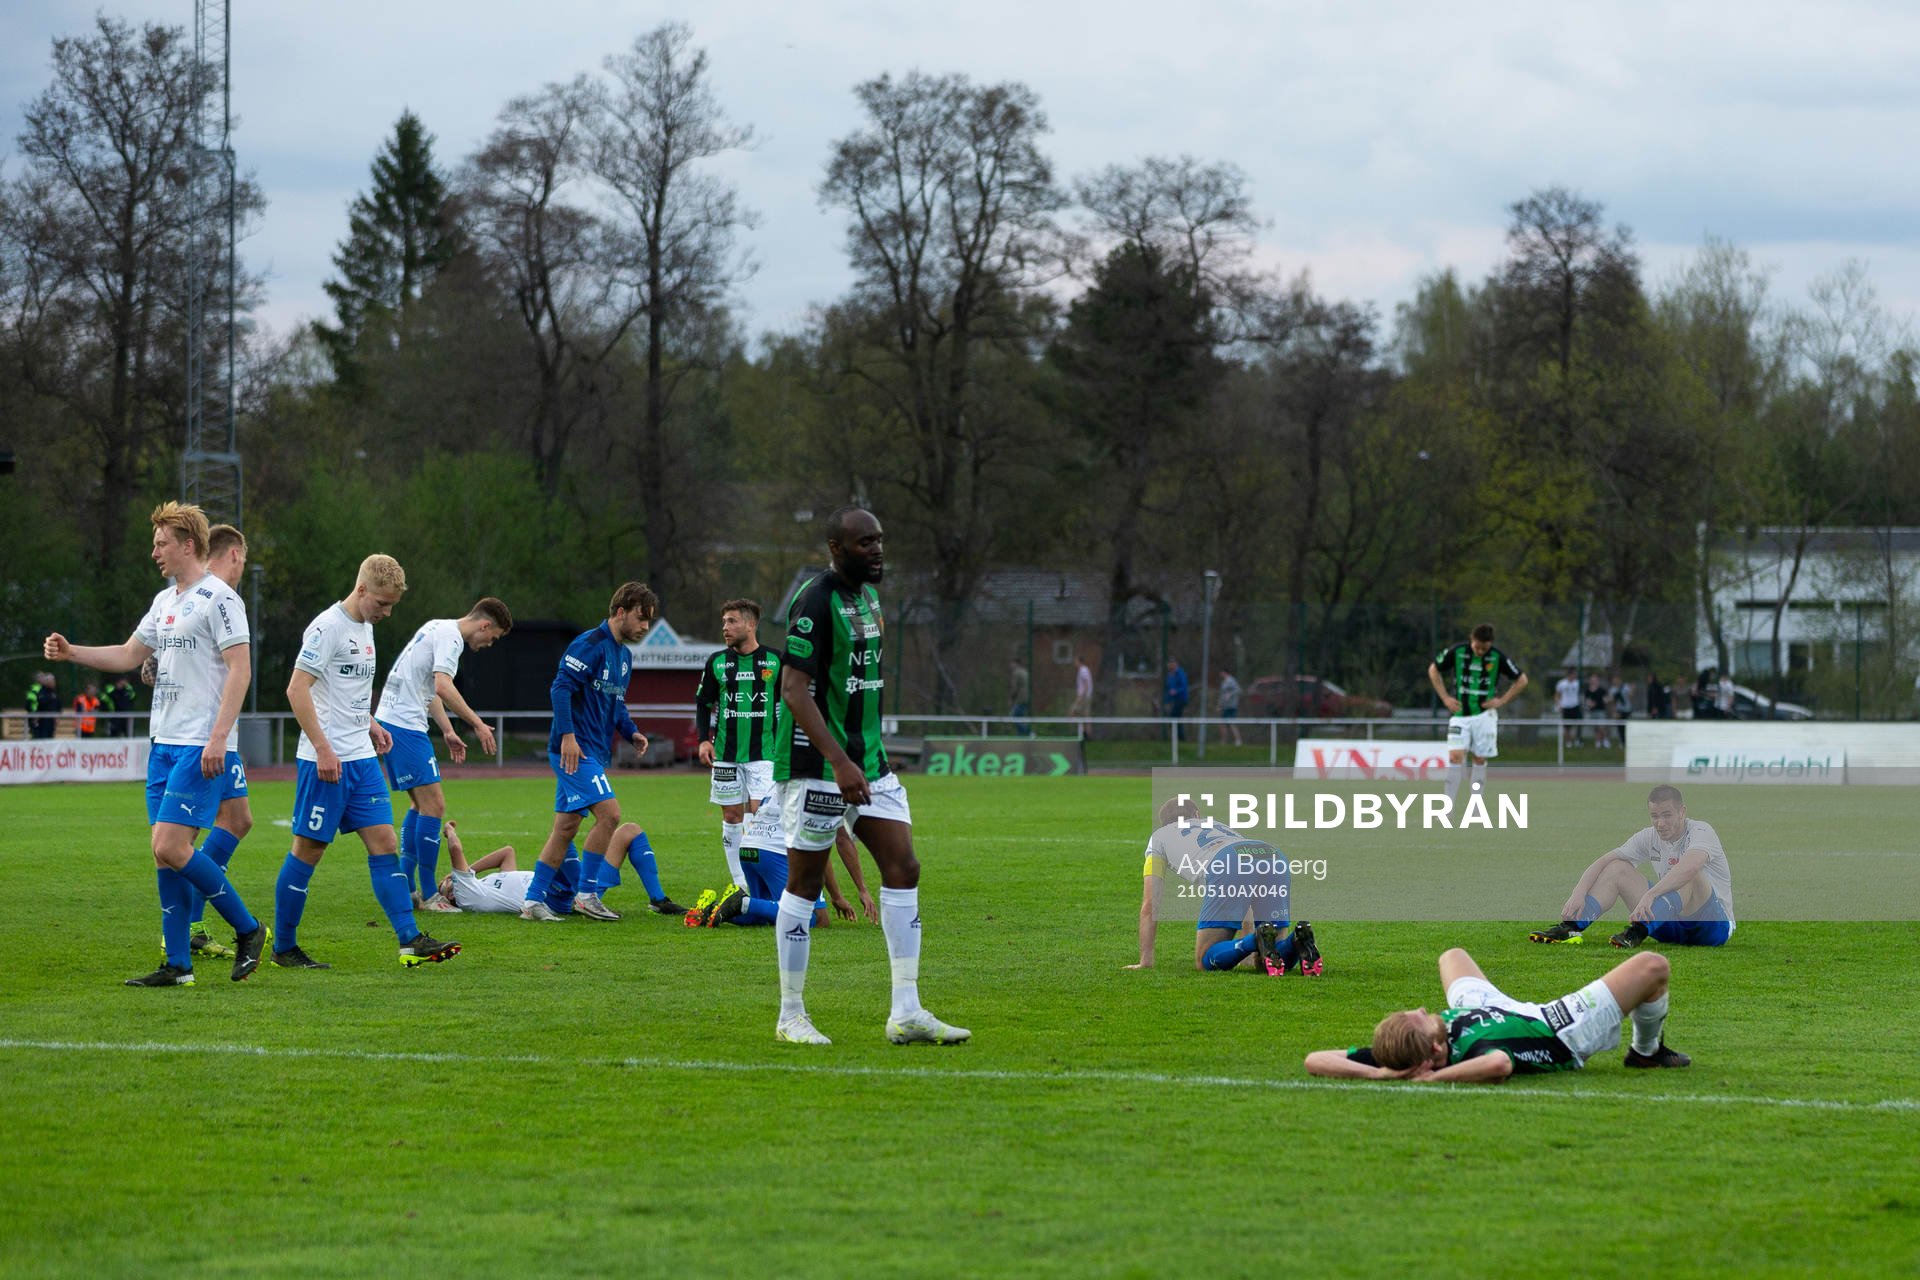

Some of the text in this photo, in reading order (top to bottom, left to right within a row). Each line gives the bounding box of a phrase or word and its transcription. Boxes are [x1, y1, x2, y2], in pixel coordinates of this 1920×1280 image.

[564, 655, 588, 671] UNIBET
[724, 692, 769, 702] NEVS
[30, 747, 53, 770] för
[56, 748, 77, 768] att
[81, 745, 129, 774] synas!
[927, 744, 1026, 776] akea
[1714, 754, 1832, 782] Liljedahl
[592, 774, 612, 795] 11
[809, 792, 846, 806] VIRTUAL
[308, 805, 326, 831] 5
